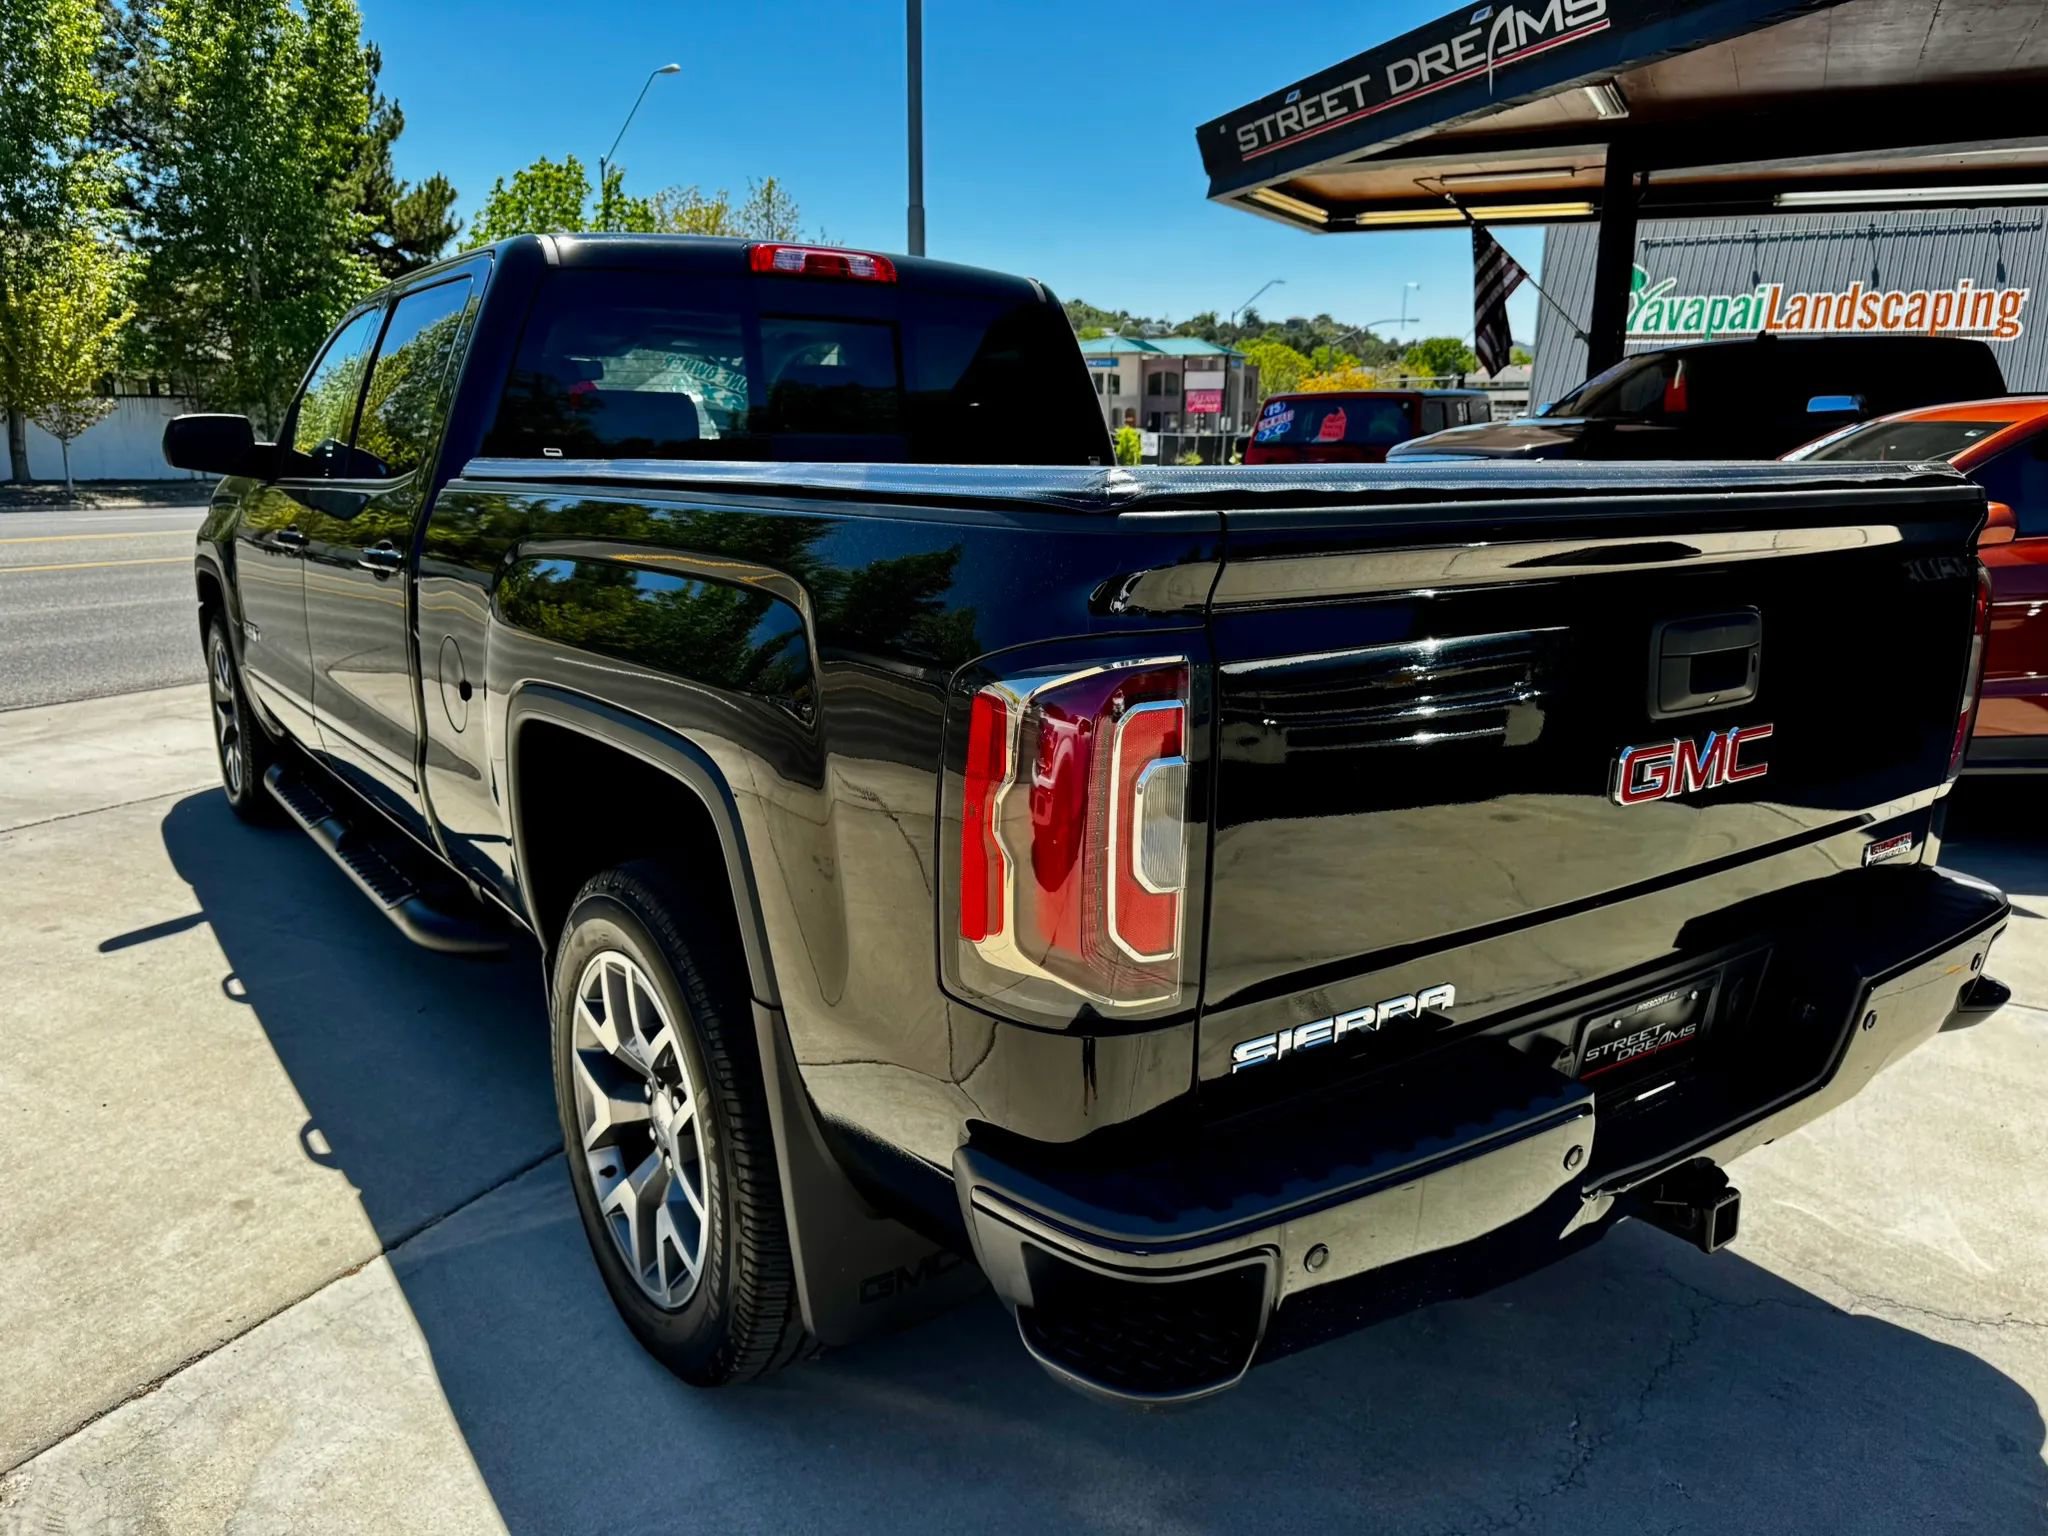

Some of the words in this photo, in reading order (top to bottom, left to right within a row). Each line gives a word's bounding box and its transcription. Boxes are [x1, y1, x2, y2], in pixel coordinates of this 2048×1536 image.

[1236, 74, 1371, 152] STREET
[1386, 0, 1607, 96] DREAMS
[1611, 723, 1774, 807] GMC
[1232, 983, 1456, 1074] SIERRA
[1585, 1022, 1667, 1062] STREET
[1616, 1023, 1697, 1062] DREAMS
